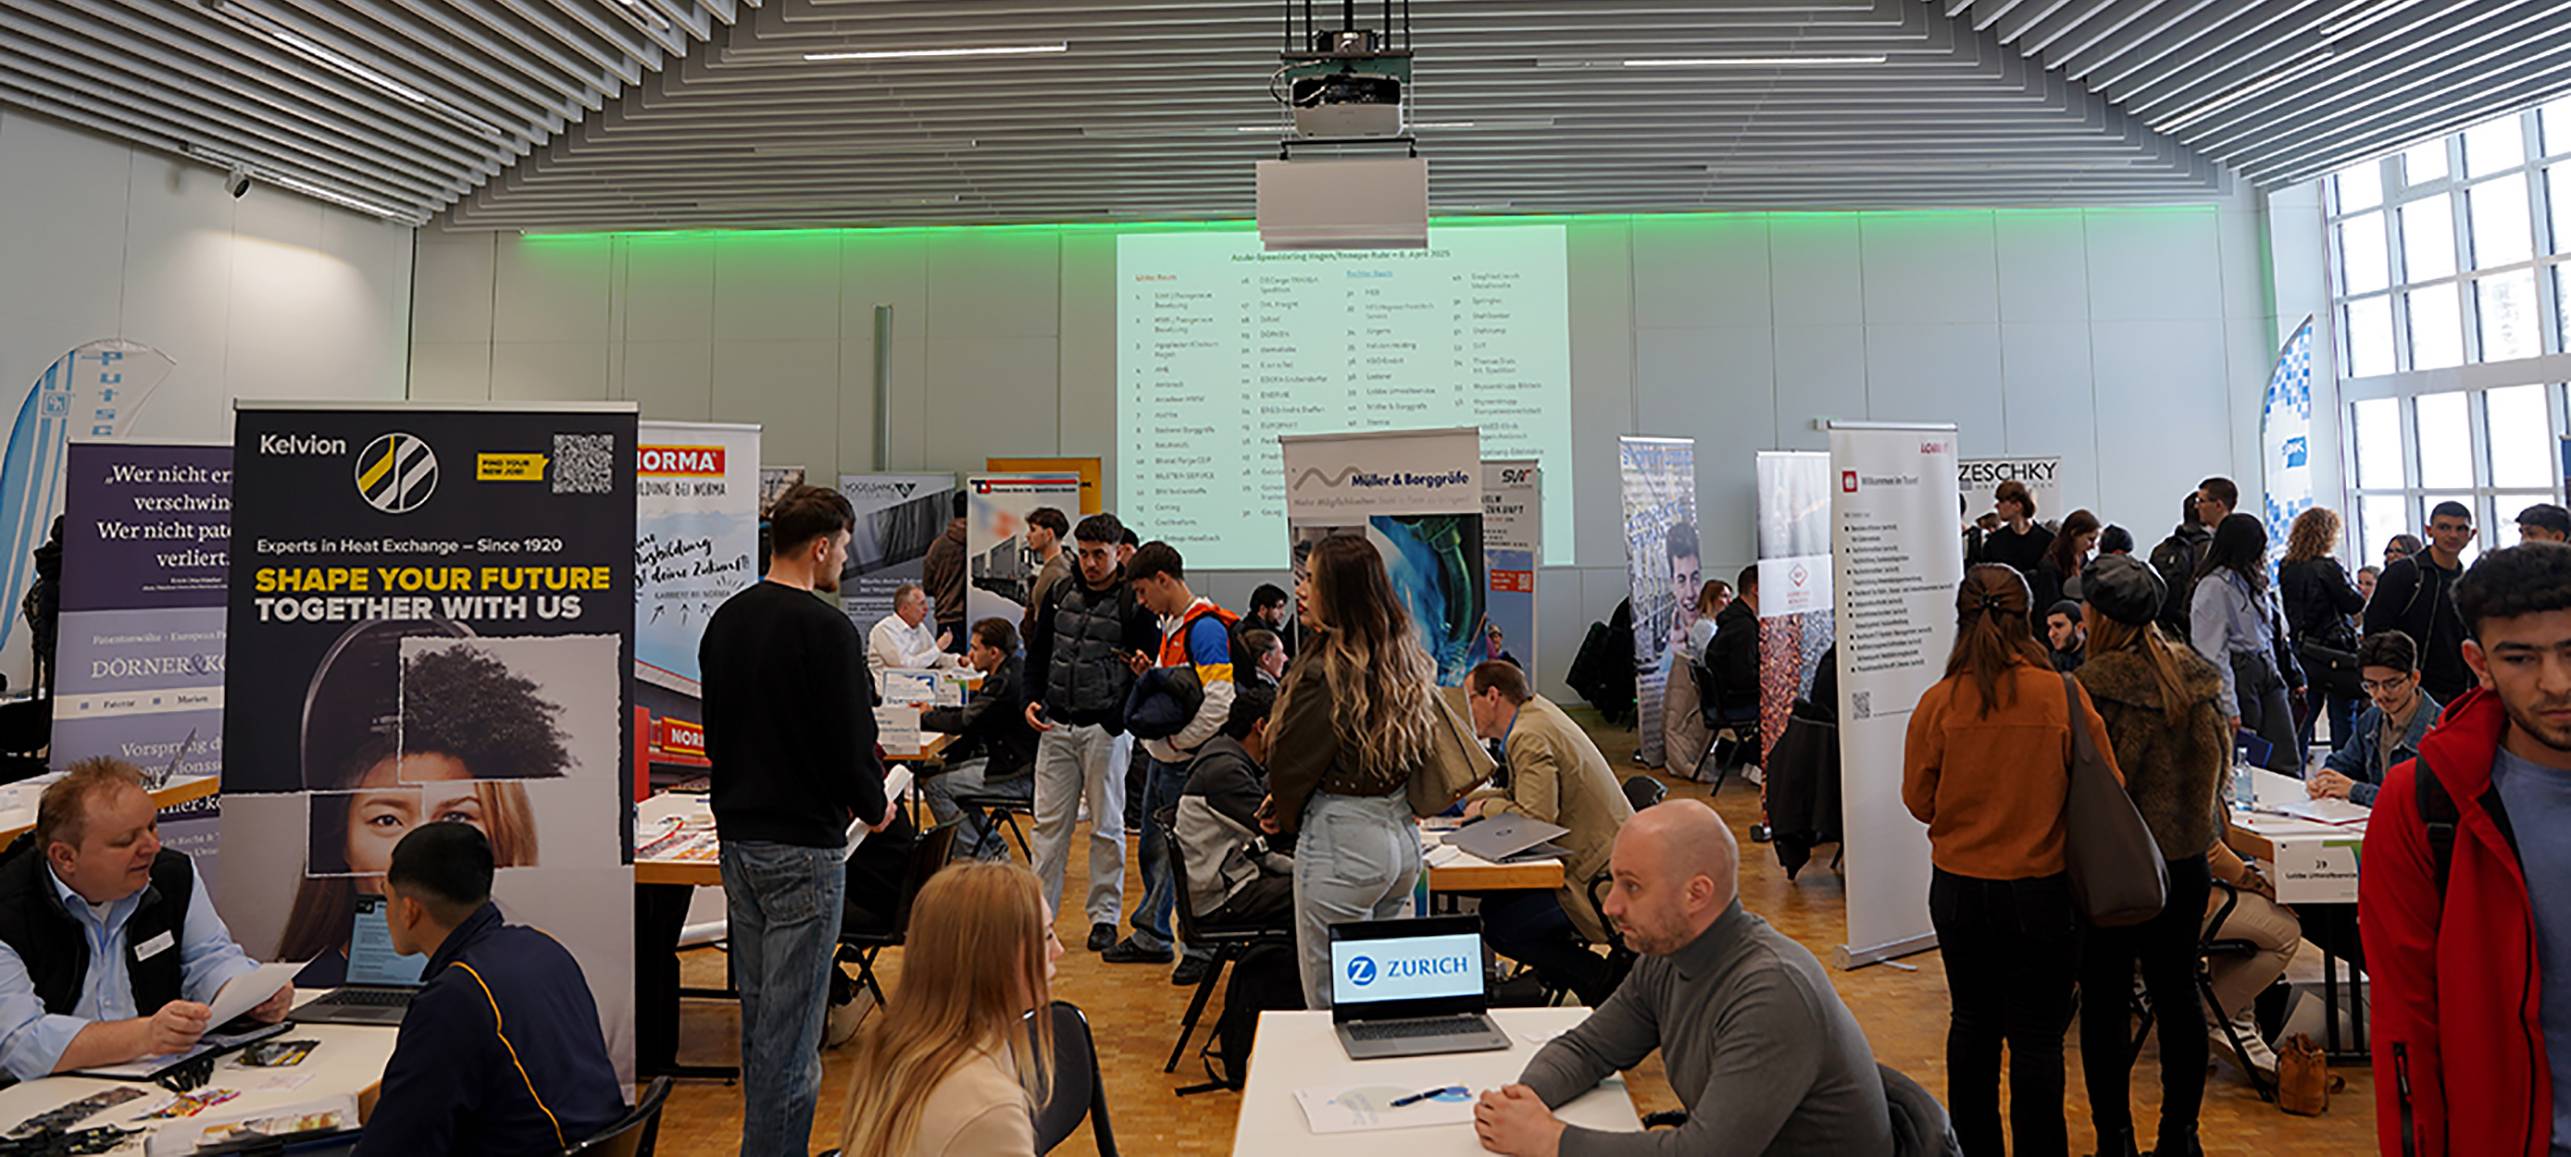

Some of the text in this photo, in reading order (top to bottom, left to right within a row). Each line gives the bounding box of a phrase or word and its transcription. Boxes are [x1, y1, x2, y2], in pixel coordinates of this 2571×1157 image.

[260, 434, 347, 455] Kelvion
[104, 465, 154, 485] „Wer
[158, 465, 207, 483] nicht
[1352, 471, 1470, 489] Müller & Borggräfe
[1958, 463, 2056, 482] ZESCHKY
[133, 495, 232, 512] verschwin
[97, 521, 140, 539] Wer
[144, 520, 195, 539] nicht
[257, 538, 317, 556] Experts
[321, 538, 337, 553] in
[341, 538, 379, 553] Heat
[383, 538, 459, 556] Exchange
[478, 538, 521, 553] Since
[525, 538, 563, 553] 1920
[255, 566, 612, 593] SHAPE YOUR FUTURE
[254, 595, 582, 622] TOGETHER WITH US
[1387, 956, 1468, 977] ZURICH
